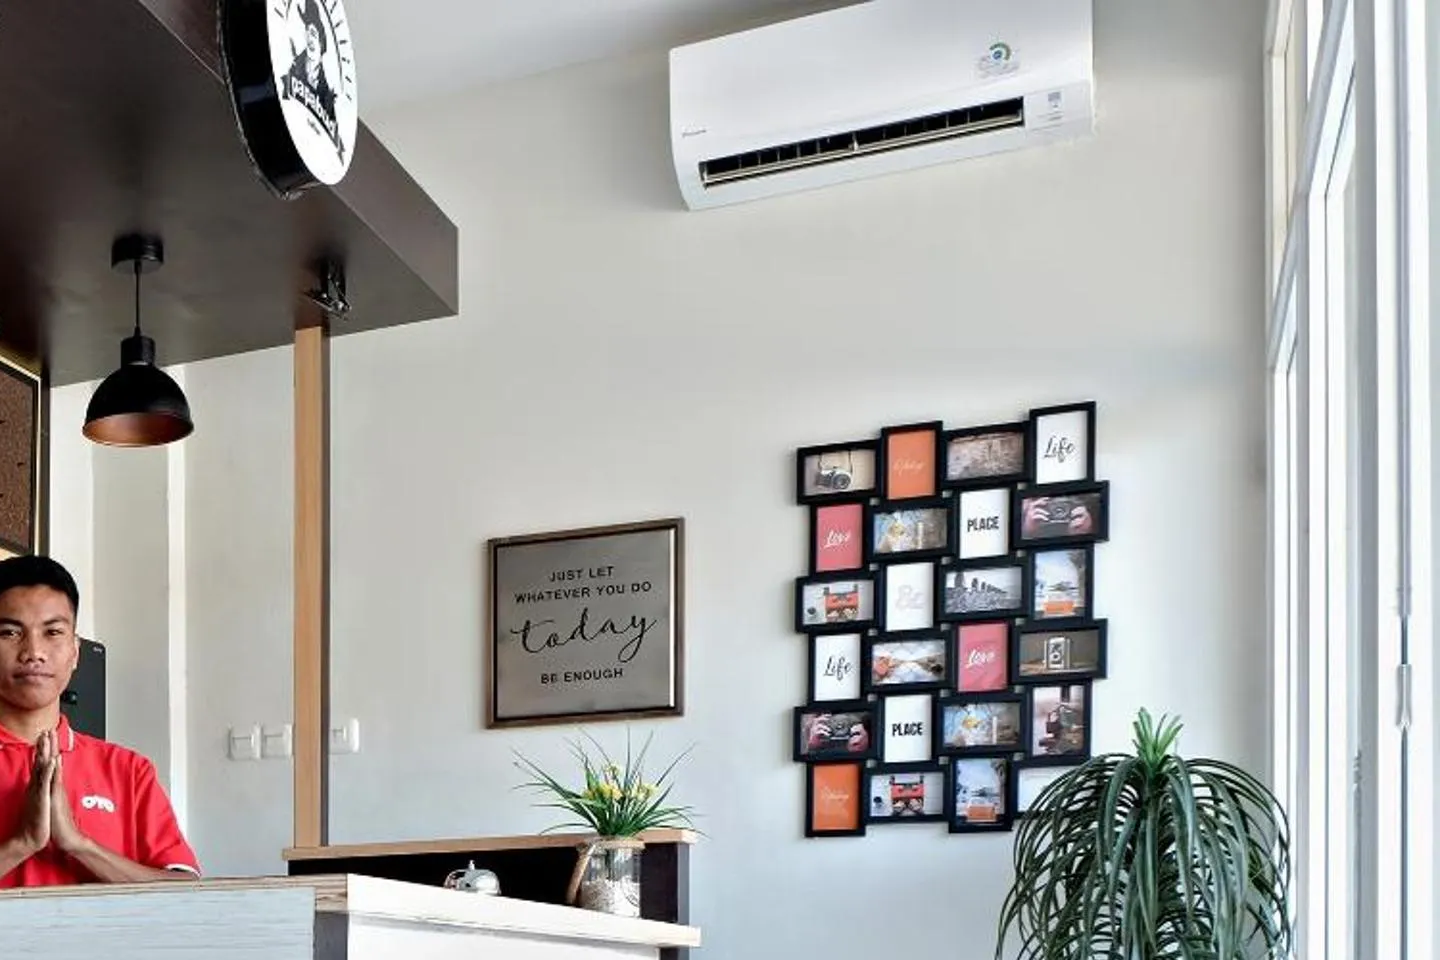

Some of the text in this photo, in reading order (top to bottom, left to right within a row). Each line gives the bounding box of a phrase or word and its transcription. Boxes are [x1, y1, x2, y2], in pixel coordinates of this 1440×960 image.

[1043, 435, 1076, 464] Life
[966, 515, 1000, 533] PLACE
[549, 565, 615, 582] JUST LET
[514, 581, 652, 604] WHATEVER YOU DO
[510, 606, 658, 664] today
[540, 667, 624, 684] BE ENOUGH
[823, 655, 853, 682] Life
[891, 721, 924, 738] PLACE
[81, 795, 116, 813] OYO
